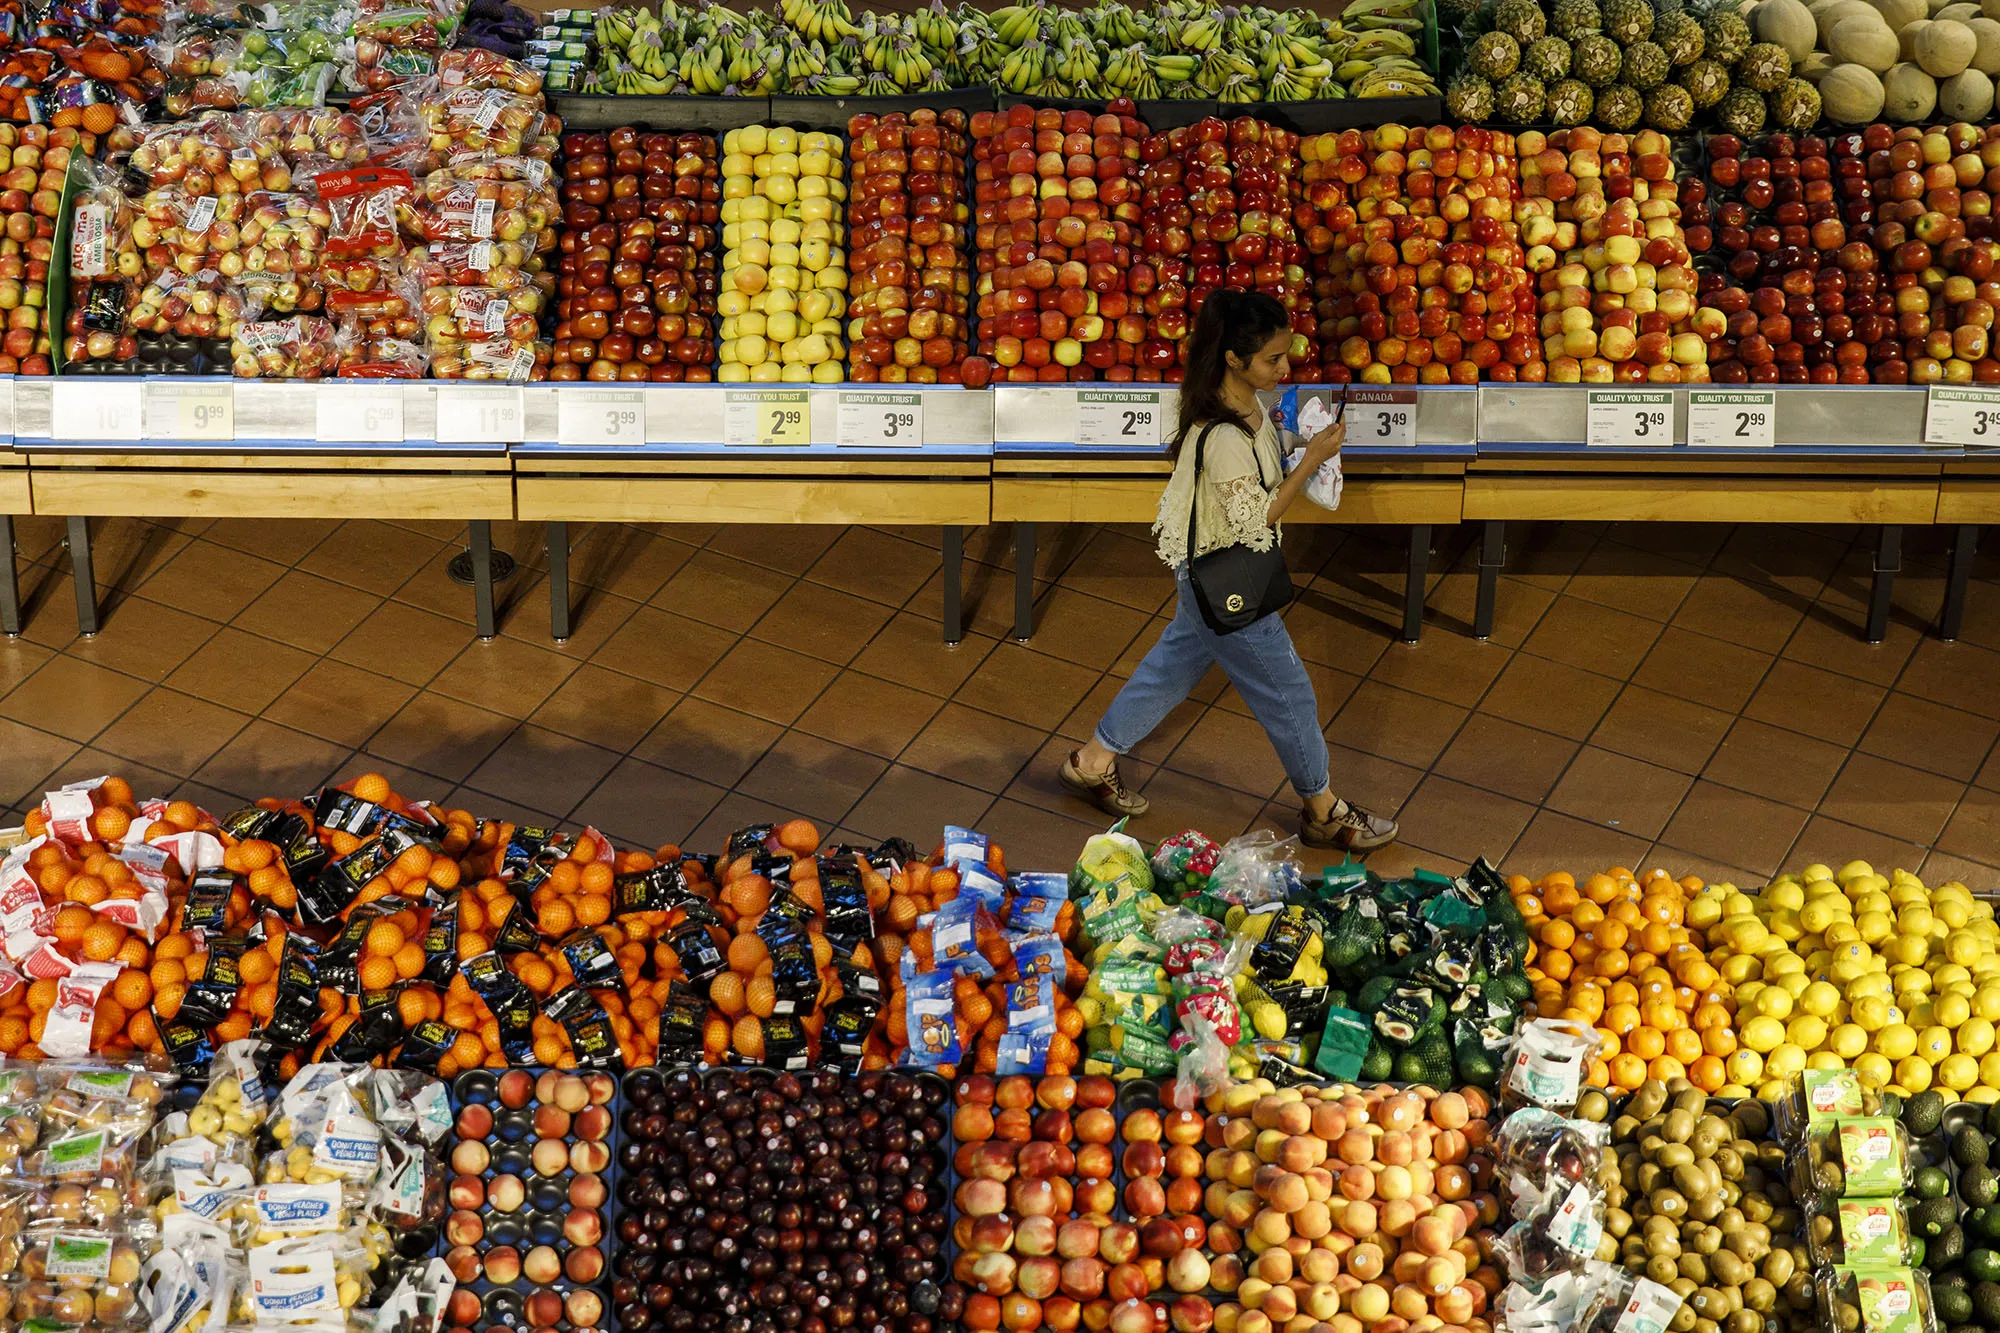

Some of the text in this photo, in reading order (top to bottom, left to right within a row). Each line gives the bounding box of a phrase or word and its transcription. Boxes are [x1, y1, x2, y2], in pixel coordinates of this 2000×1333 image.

[240, 271, 282, 281] AMBROSIA
[509, 350, 526, 380] oneycrisp
[733, 393, 800, 401] QUALITY YOU TRUST
[876, 395, 890, 403] YOU
[1084, 393, 1113, 401] QUALITY
[1114, 393, 1128, 401] YOU
[1355, 393, 1394, 402] CANADA
[1596, 394, 1665, 402] QUALITY YOU TRUST
[1938, 391, 2000, 402] QUALITY YOU TRUS
[331, 1140, 353, 1149] DONUT
[297, 1209, 321, 1217] PLATES
